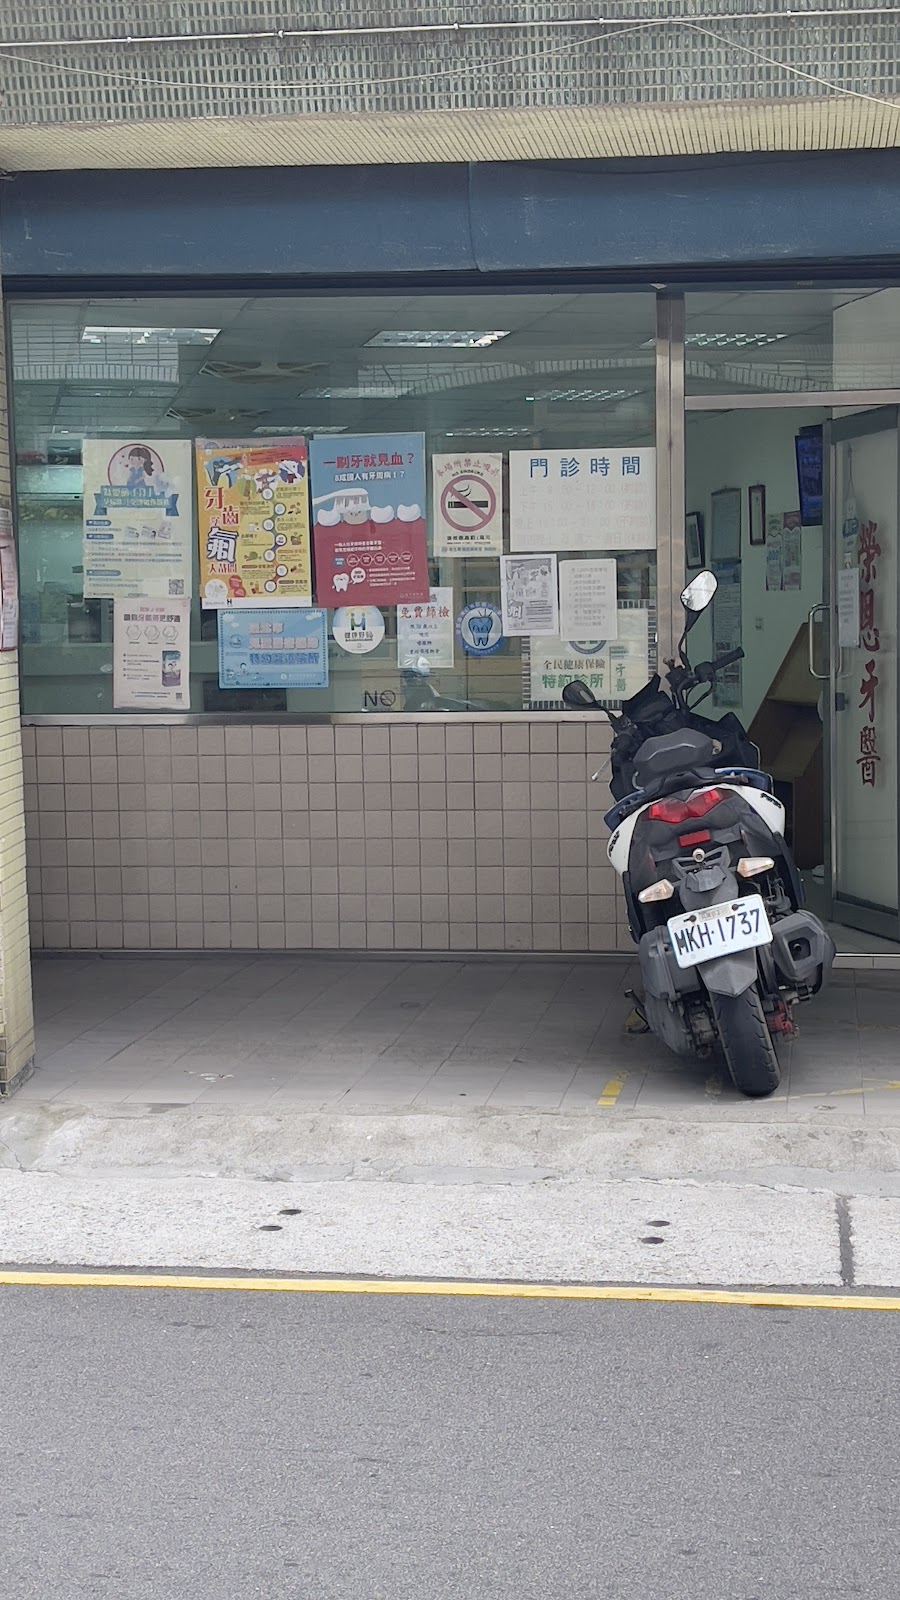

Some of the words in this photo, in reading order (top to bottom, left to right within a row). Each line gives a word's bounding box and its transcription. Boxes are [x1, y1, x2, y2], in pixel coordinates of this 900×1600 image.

[530, 456, 640, 478] 門診時間
[543, 658, 606, 670] 全民健康保險
[857, 519, 881, 787] 榮恩牙醫
